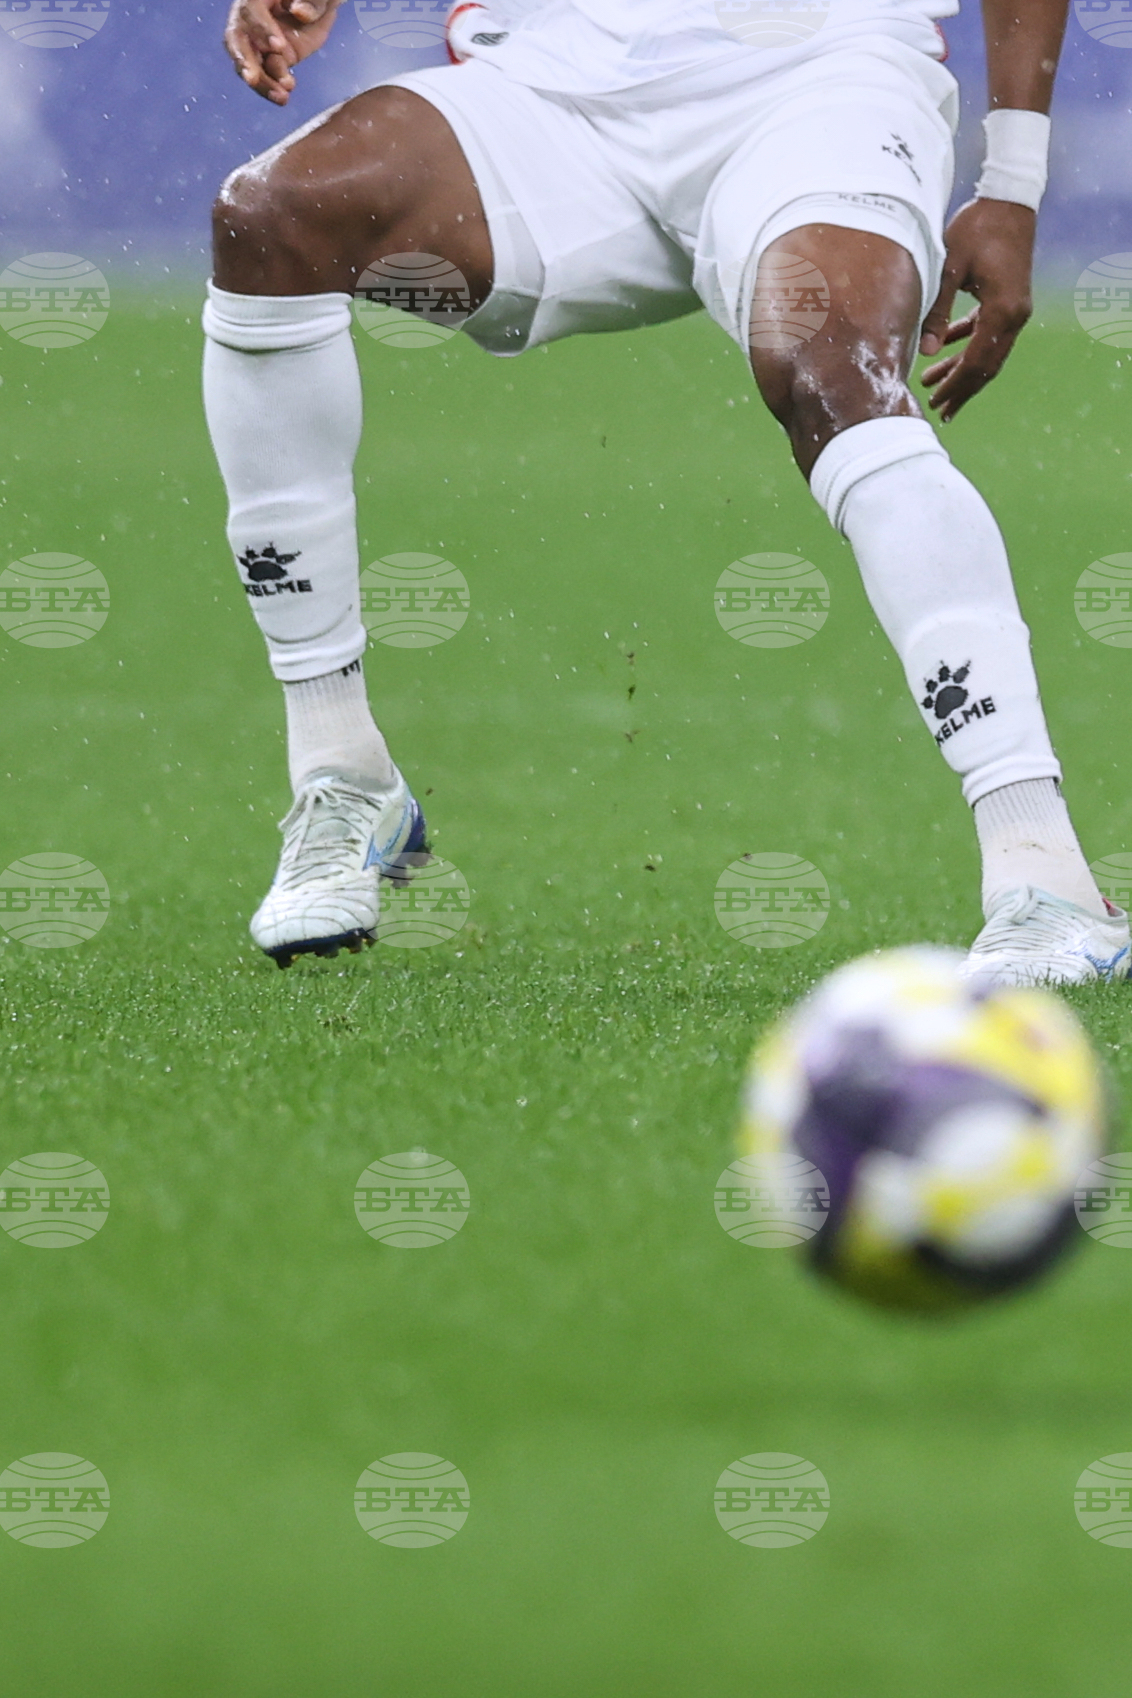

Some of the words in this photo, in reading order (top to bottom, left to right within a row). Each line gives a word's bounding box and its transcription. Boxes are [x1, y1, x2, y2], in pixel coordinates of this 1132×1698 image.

[838, 192, 896, 213] KELME
[243, 578, 314, 598] KELME
[934, 695, 997, 748] KELME
